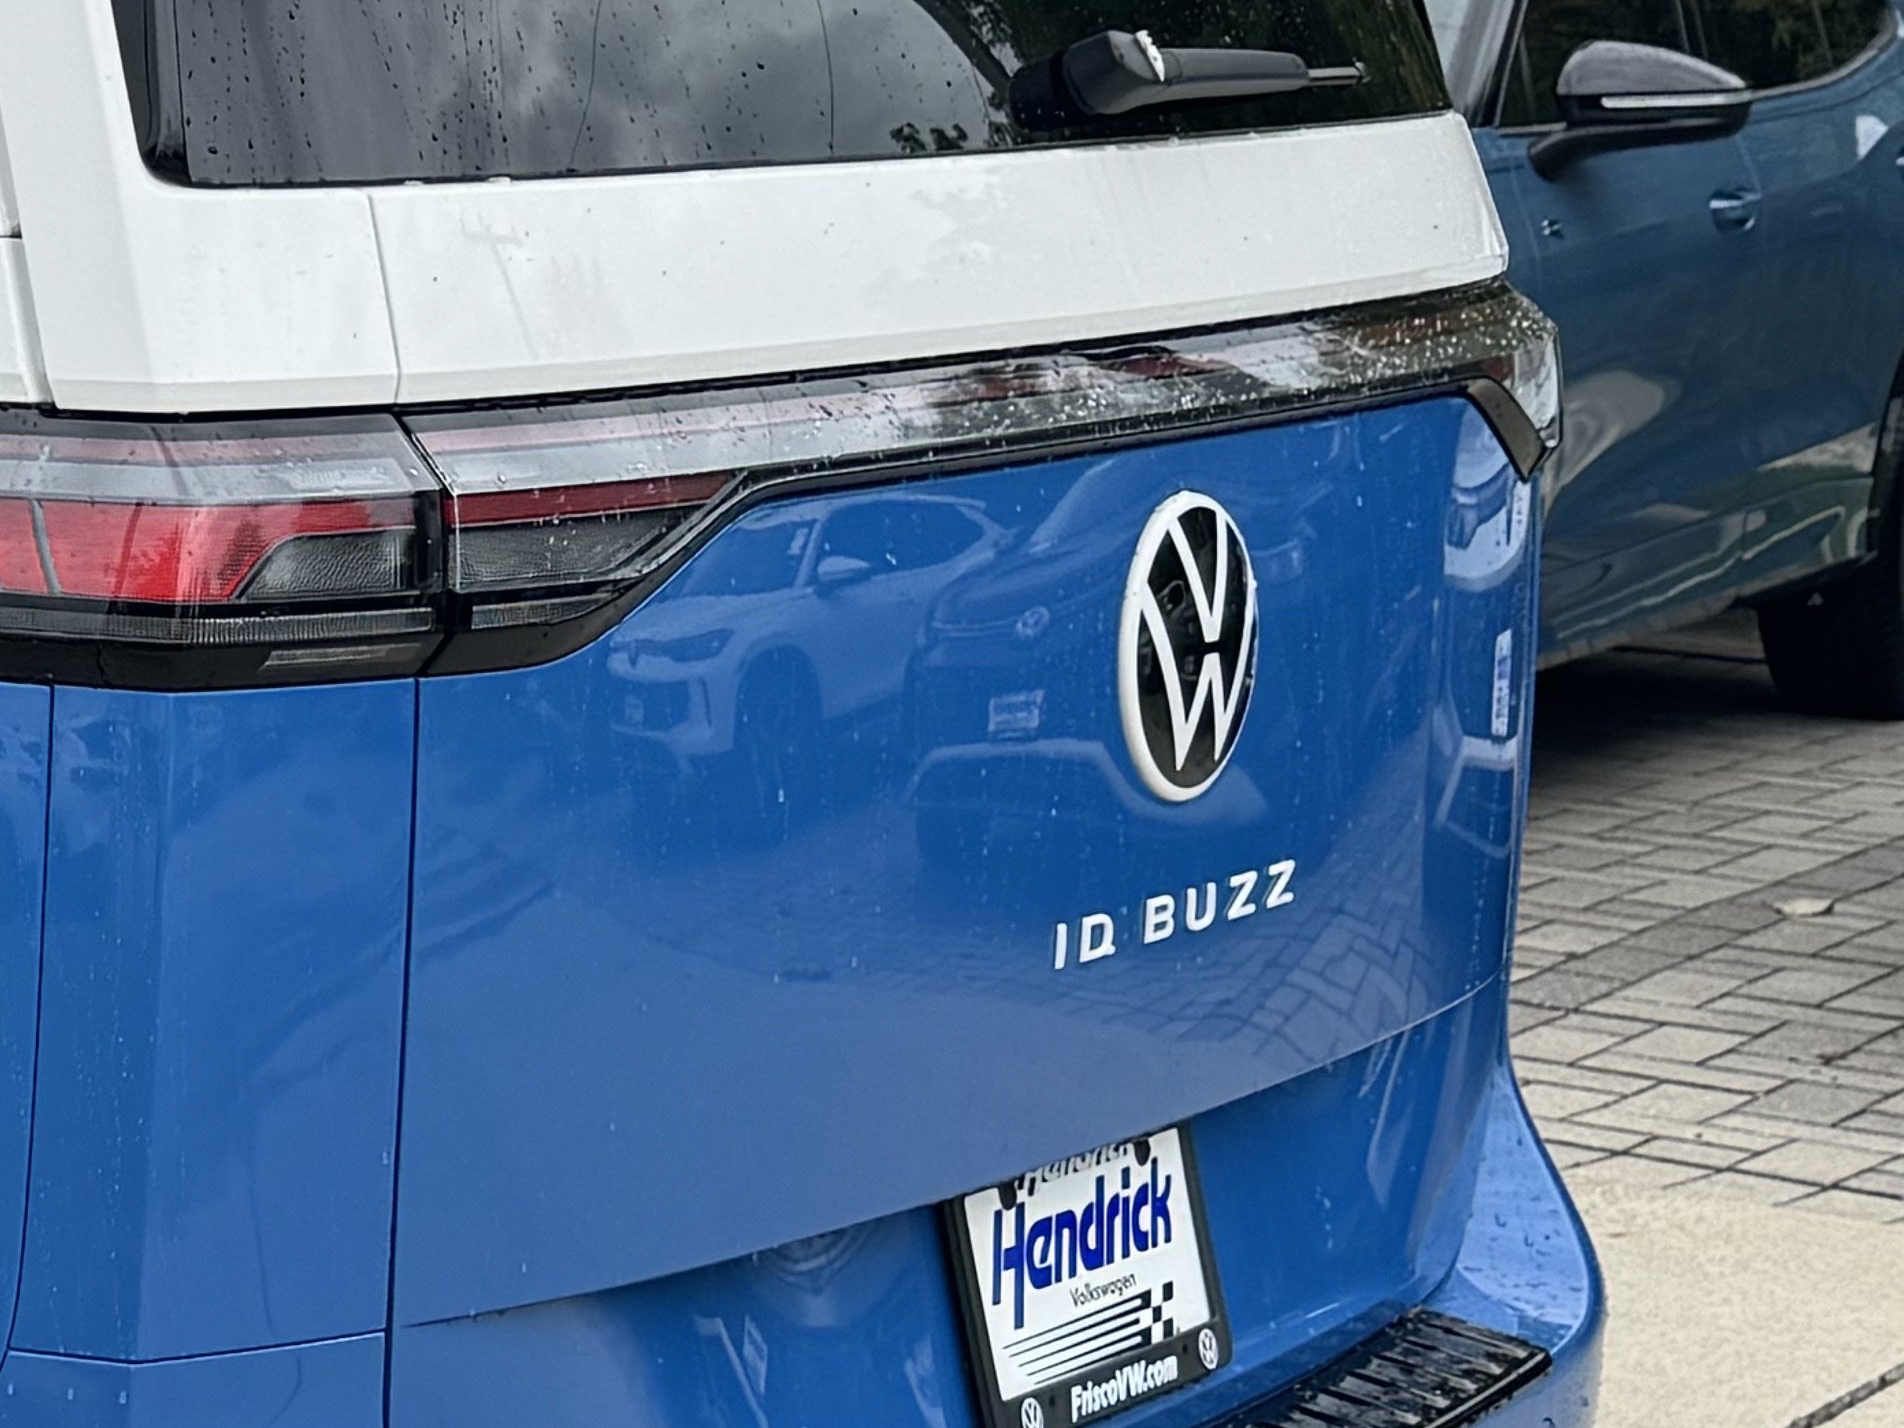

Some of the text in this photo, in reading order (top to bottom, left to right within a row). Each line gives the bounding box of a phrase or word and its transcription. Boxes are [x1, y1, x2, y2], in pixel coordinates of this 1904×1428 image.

[1143, 858, 1296, 944] BUZZ
[991, 1155, 1173, 1331] Hendrick
[1070, 1355, 1179, 1424] FriscoVW.com
